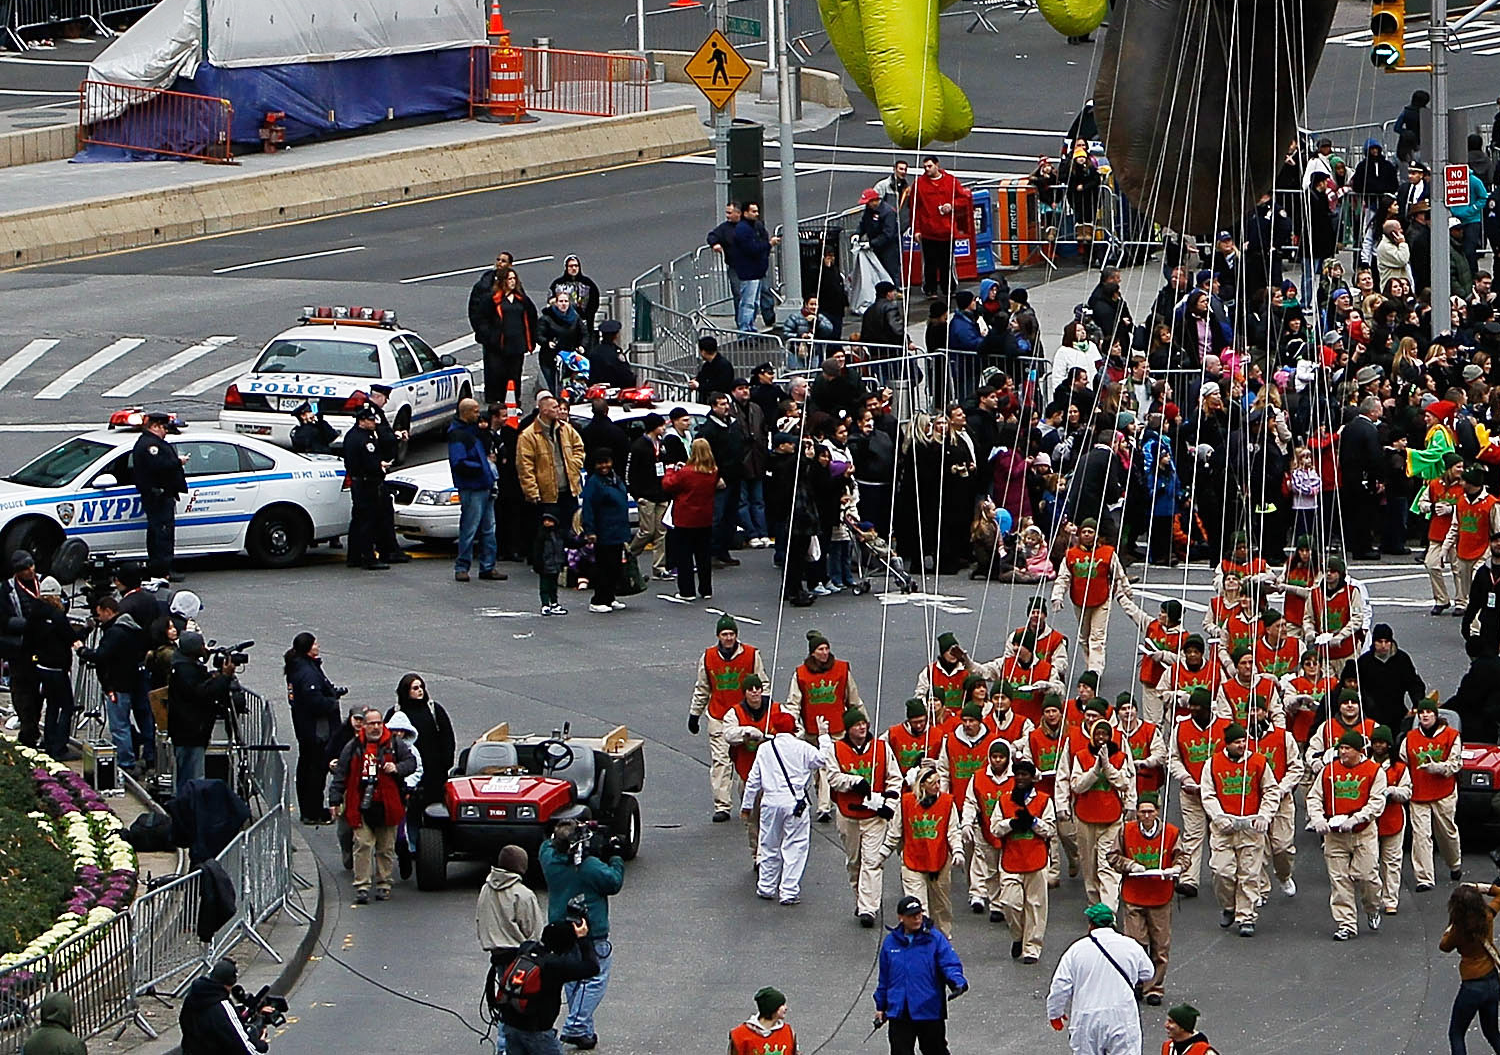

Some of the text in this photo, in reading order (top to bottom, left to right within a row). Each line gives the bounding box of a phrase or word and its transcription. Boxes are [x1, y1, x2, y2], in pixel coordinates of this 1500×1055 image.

[1451, 170, 1463, 178] NO
[1447, 187, 1466, 195] ANYTIME
[1011, 235, 1019, 260] meto
[250, 382, 337, 396] POLICE
[0, 500, 24, 511] POLICE
[78, 497, 146, 523] NYPD
